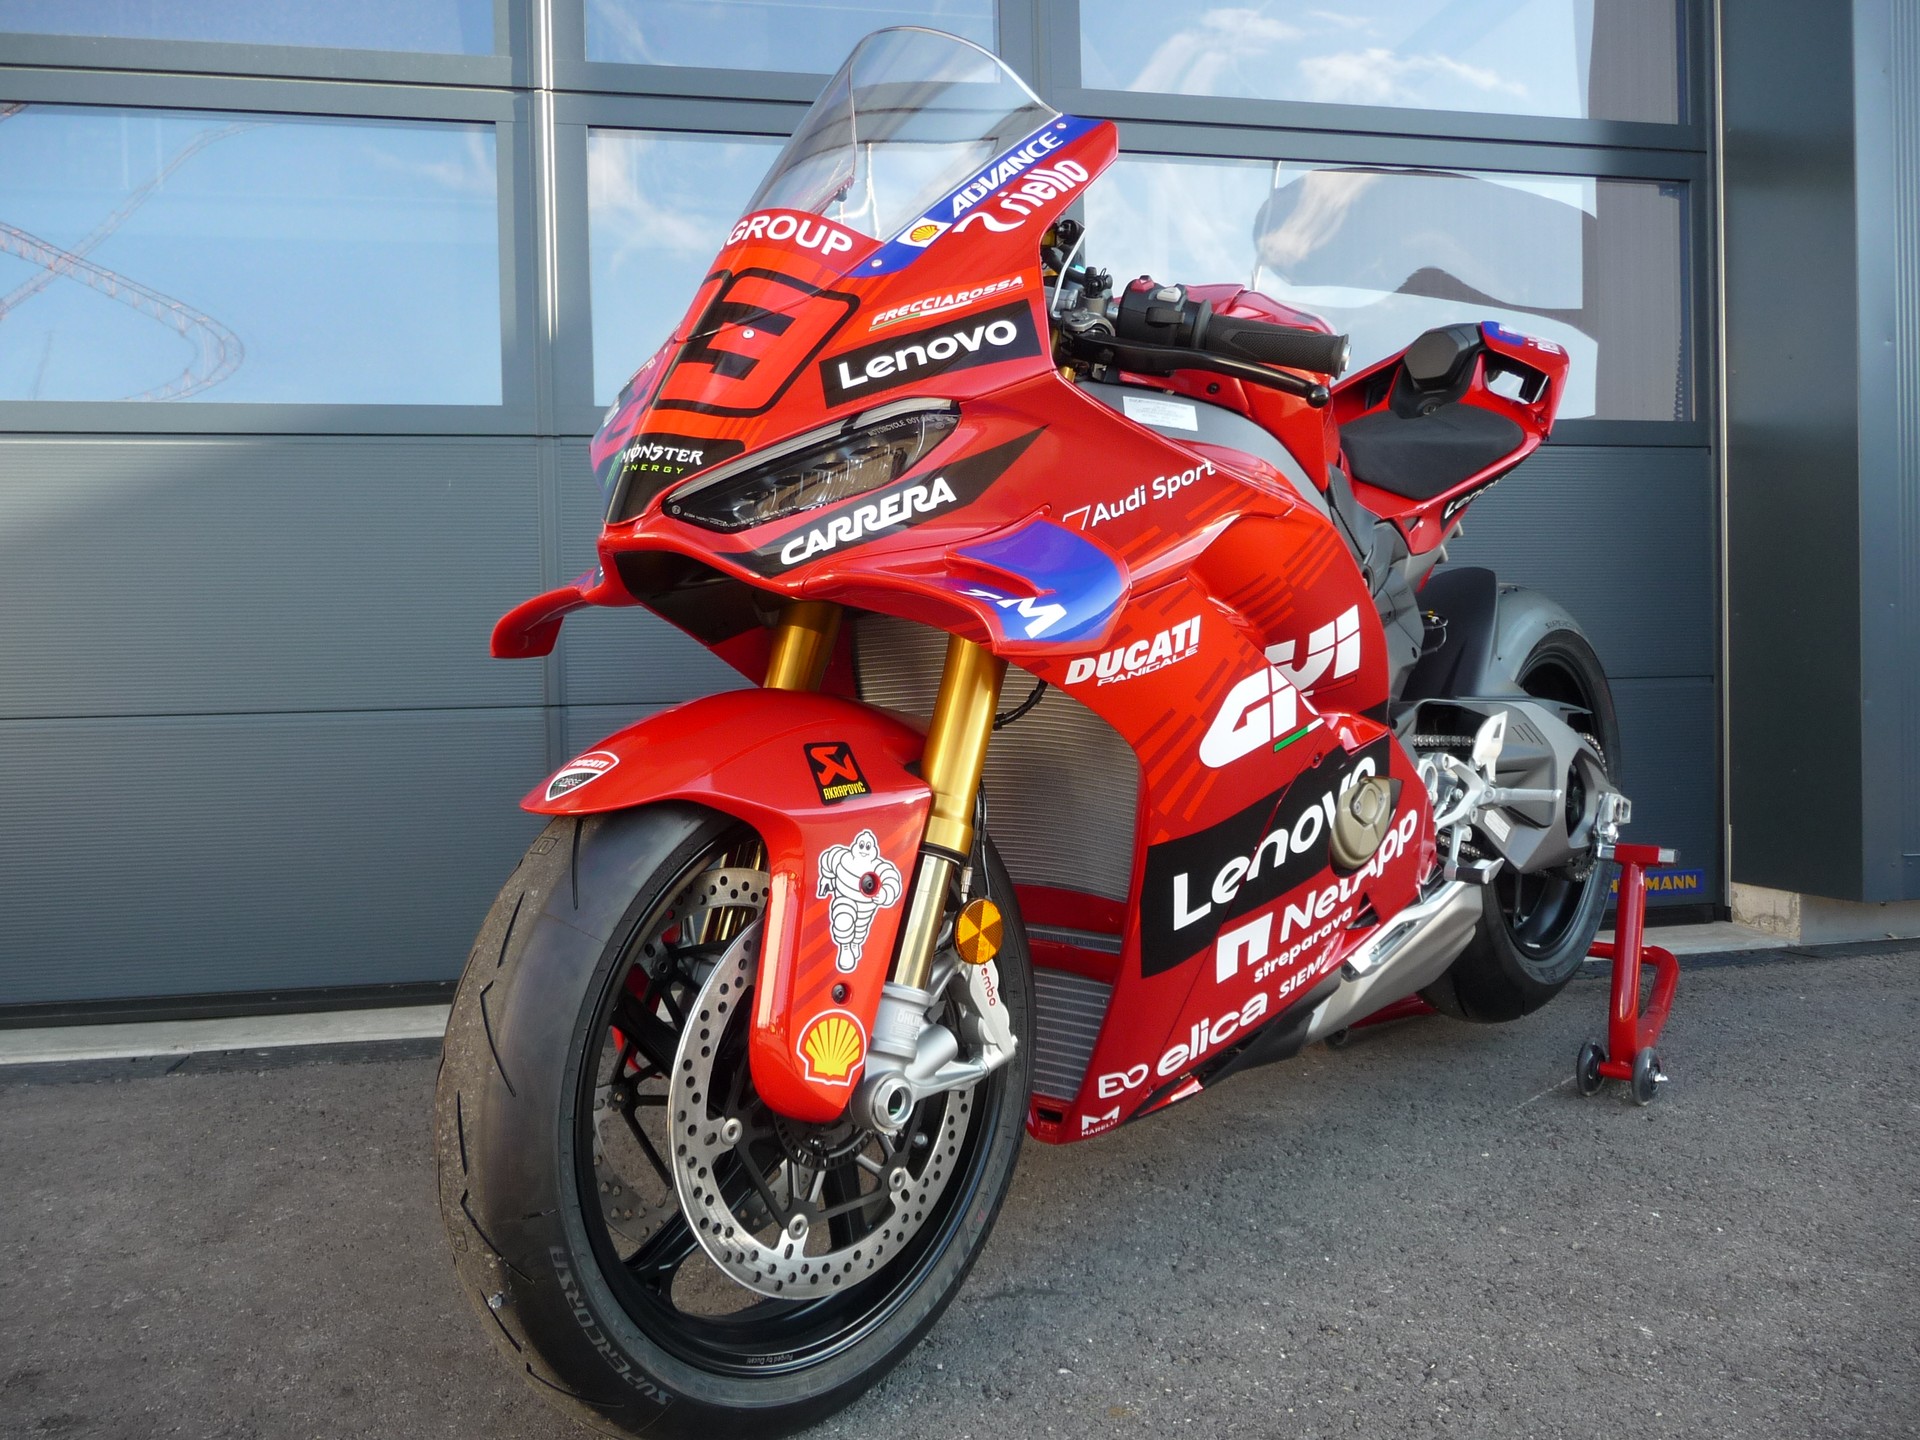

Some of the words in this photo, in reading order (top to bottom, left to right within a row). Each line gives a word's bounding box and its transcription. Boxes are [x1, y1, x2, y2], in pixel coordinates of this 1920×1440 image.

[953, 131, 1064, 219] ADVANCE
[997, 159, 1089, 216] riello
[726, 215, 853, 256] GROUP
[871, 275, 1024, 327] FRECCIAROSSA
[838, 320, 1018, 390] Lenovo
[623, 463, 685, 475] ENERGY
[1090, 486, 1147, 529] Audi
[1152, 457, 1217, 502] Sport
[780, 477, 958, 566] CARRERA
[1064, 614, 1201, 685] DUCATI
[1097, 645, 1199, 687] PANIGALE
[1609, 874, 1697, 894] HMANN
[1254, 906, 1353, 984] streparava
[980, 962, 996, 1007] embo
[1156, 992, 1268, 1077] elica
[549, 1246, 674, 1406] SUPERCORSA
